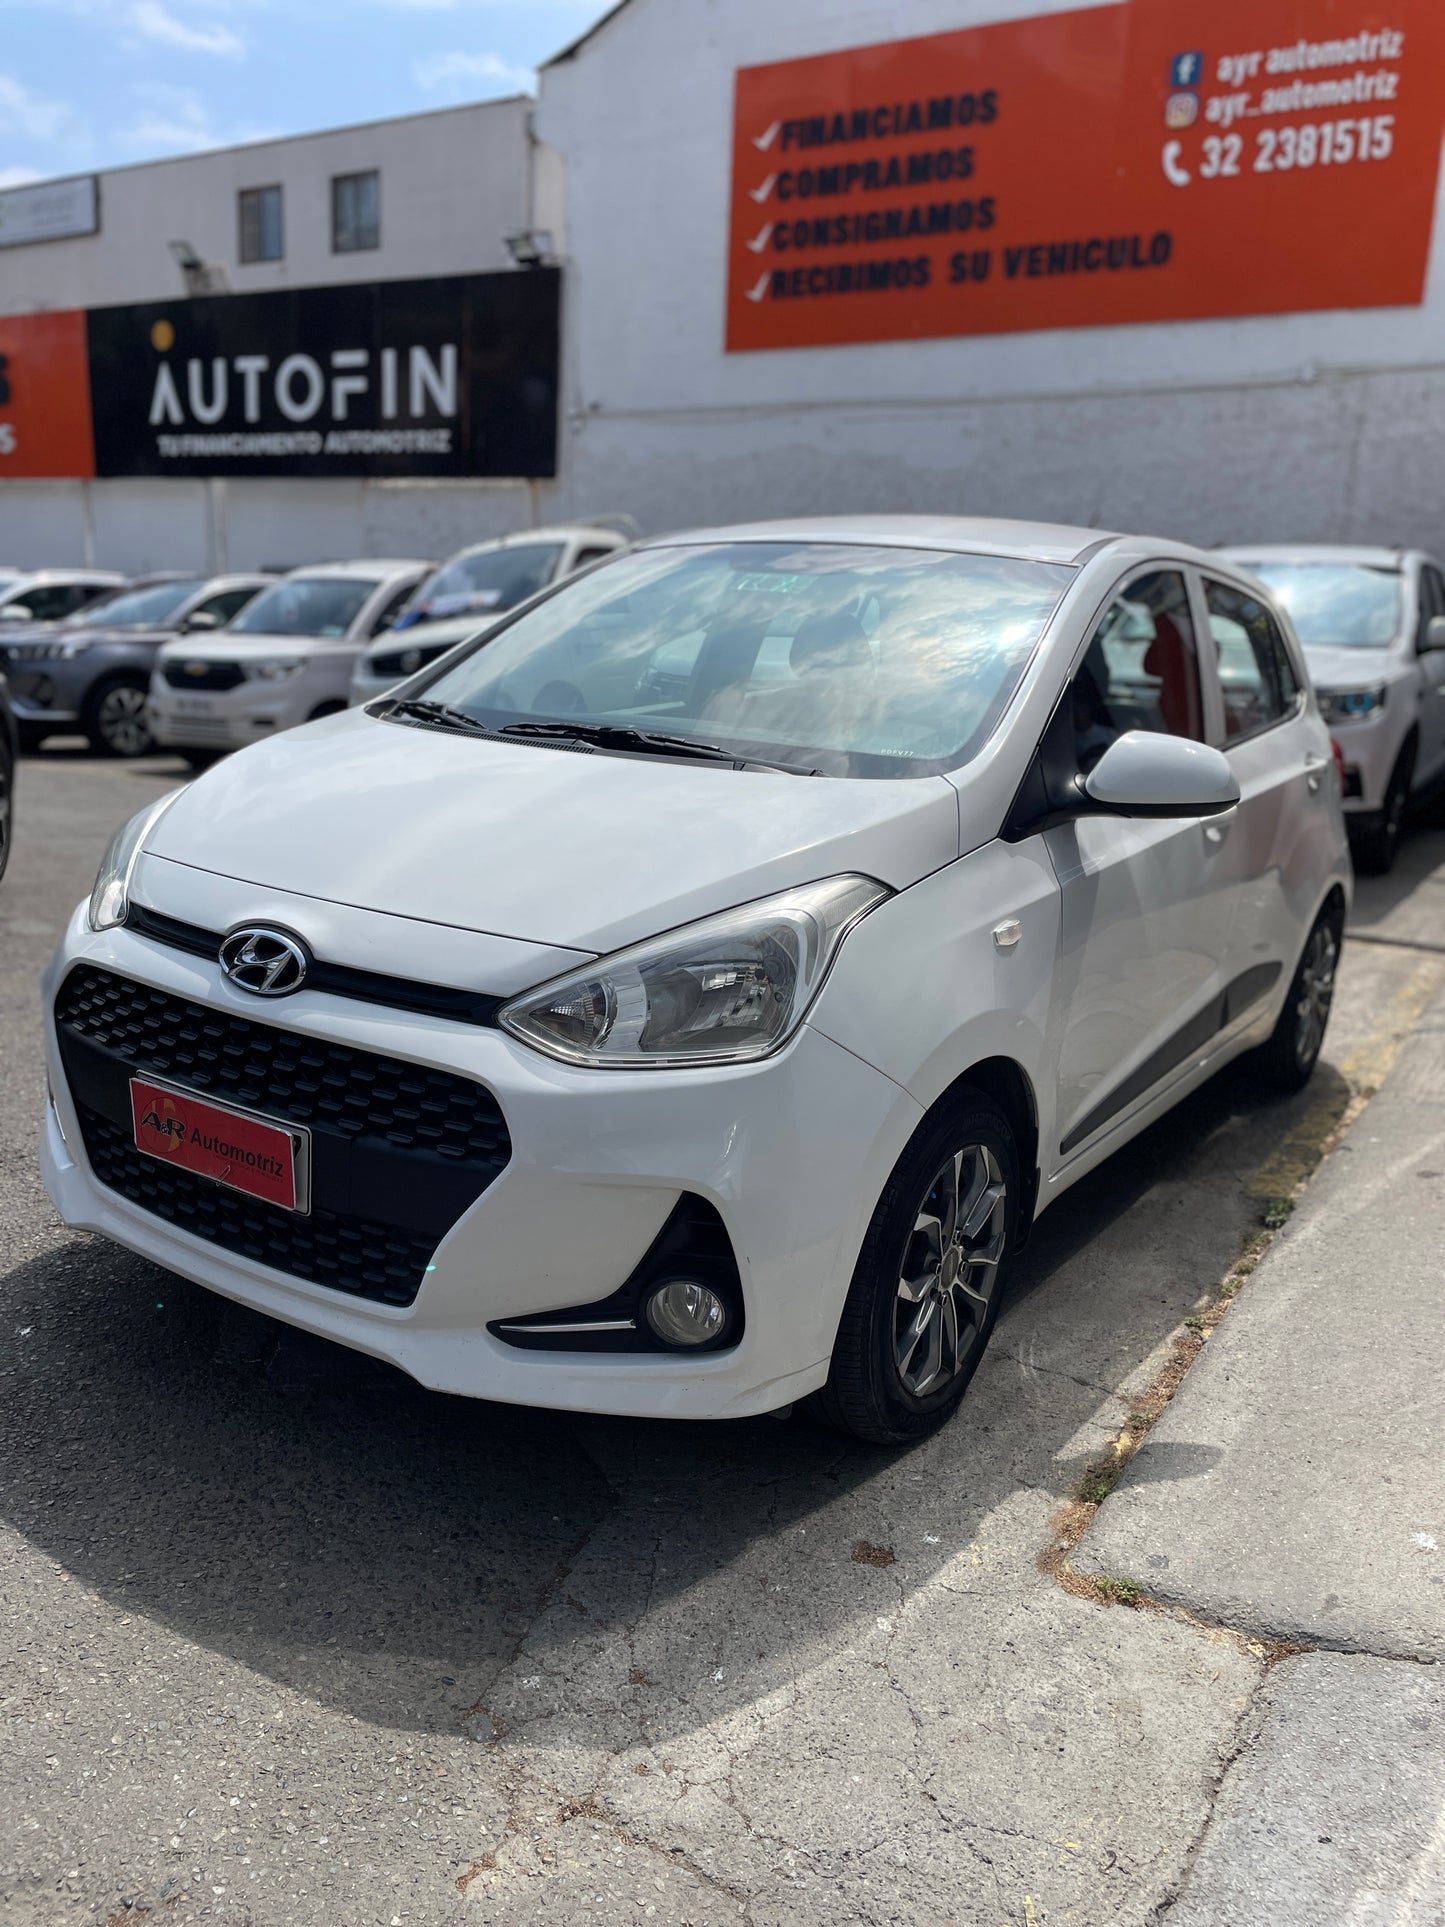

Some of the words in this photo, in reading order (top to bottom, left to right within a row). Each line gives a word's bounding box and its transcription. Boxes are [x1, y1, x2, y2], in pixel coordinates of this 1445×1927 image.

[1216, 50, 1263, 87] ayr
[1265, 27, 1403, 74] automotriz
[780, 90, 999, 152] FINANCIAMOS
[1200, 133, 1243, 178] 32
[1253, 114, 1396, 172] 2381515
[777, 147, 974, 200] COMPRAMOS
[772, 197, 995, 251] CONSIGNAMOS
[770, 257, 931, 300] RECIBIMOS
[949, 250, 991, 284] SU
[1003, 231, 1173, 279] VEHICULO
[149, 344, 457, 425] AUTOFIN
[324, 428, 452, 454] AUTOMOTRIZ
[141, 1111, 186, 1141] A&R
[190, 1127, 284, 1177] Automotriz
